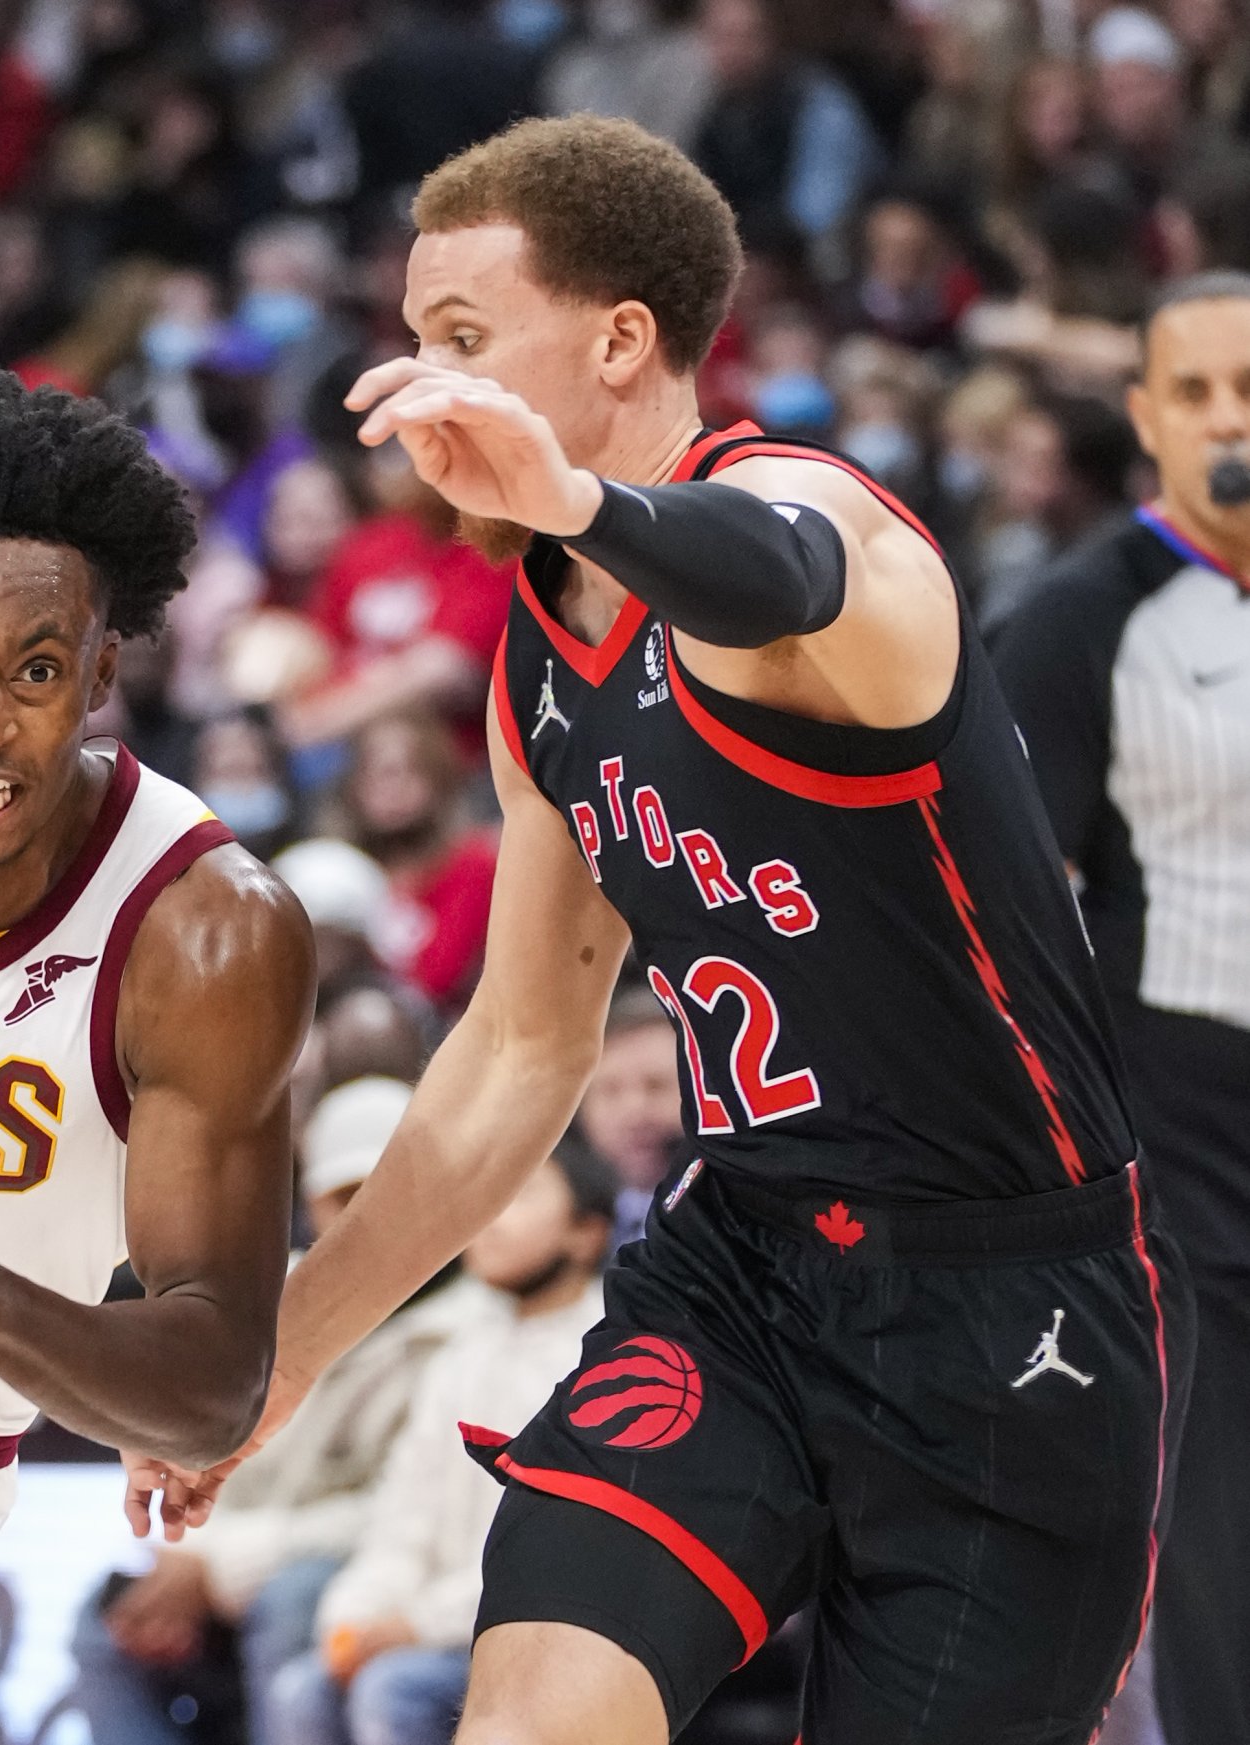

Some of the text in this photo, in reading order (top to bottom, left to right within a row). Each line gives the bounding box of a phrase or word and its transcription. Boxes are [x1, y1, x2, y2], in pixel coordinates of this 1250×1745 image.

[638, 690, 656, 709] Sun
[570, 755, 820, 938] PTORS
[648, 955, 822, 1135] 12
